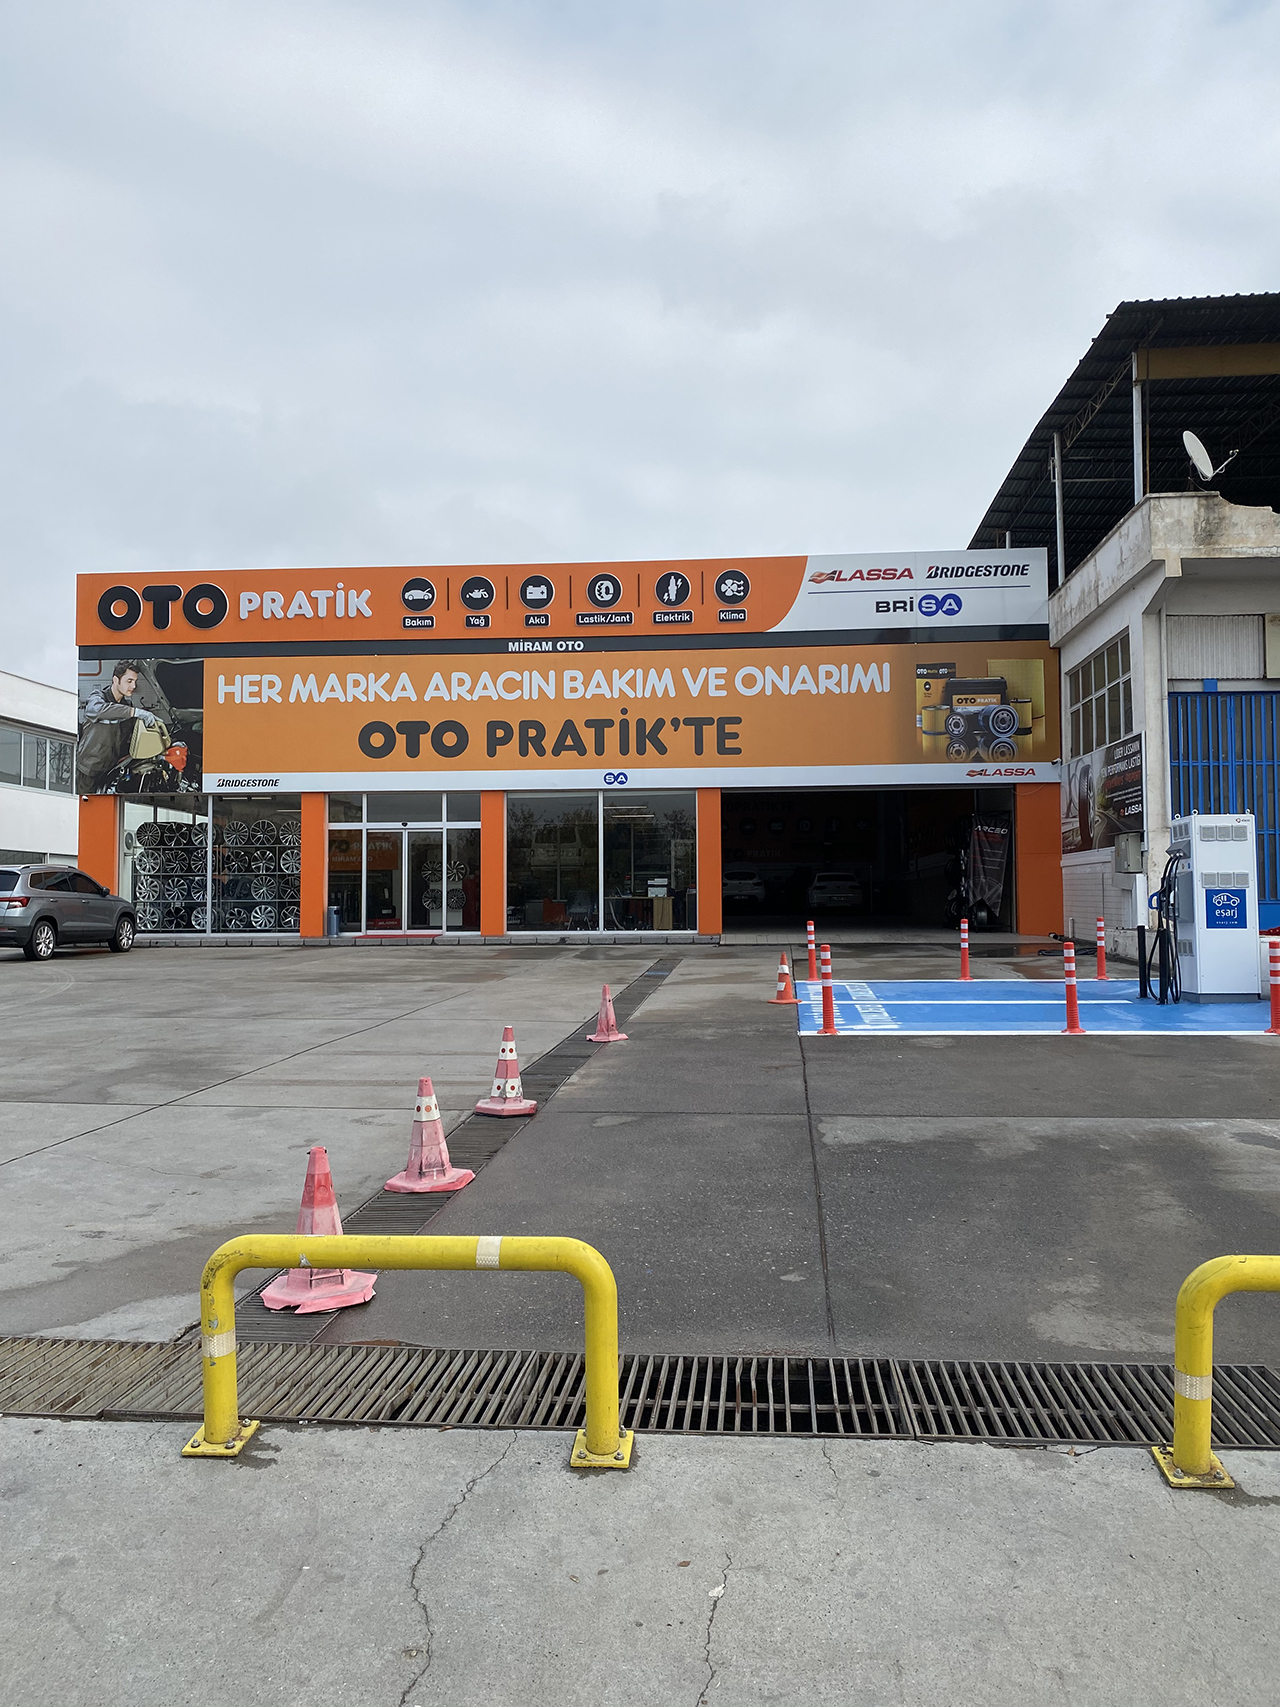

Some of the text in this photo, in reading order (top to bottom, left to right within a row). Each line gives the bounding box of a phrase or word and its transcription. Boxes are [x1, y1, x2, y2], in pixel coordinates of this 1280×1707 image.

[835, 567, 914, 582] LASSA
[926, 564, 1030, 579] BRIDGESTONE
[97, 582, 373, 632] OTO PRATİK
[528, 616, 546, 625] Akü
[578, 613, 631, 624] Lastik/Jant
[655, 612, 691, 622] Elektrik
[719, 611, 745, 620] Klima
[405, 618, 432, 627] Bakım
[469, 616, 486, 627] Yağ
[508, 639, 585, 652] MİRAM OTO
[217, 661, 891, 704] HER MARKA ARACIN BAKIM VE ONARIMI
[956, 697, 977, 705] OTO
[358, 719, 470, 759] OTO
[982, 767, 1037, 777] LASSA
[216, 778, 280, 788] BRIDGESTONE
[603, 771, 629, 785] SA
[1125, 803, 1142, 815] LASSA
